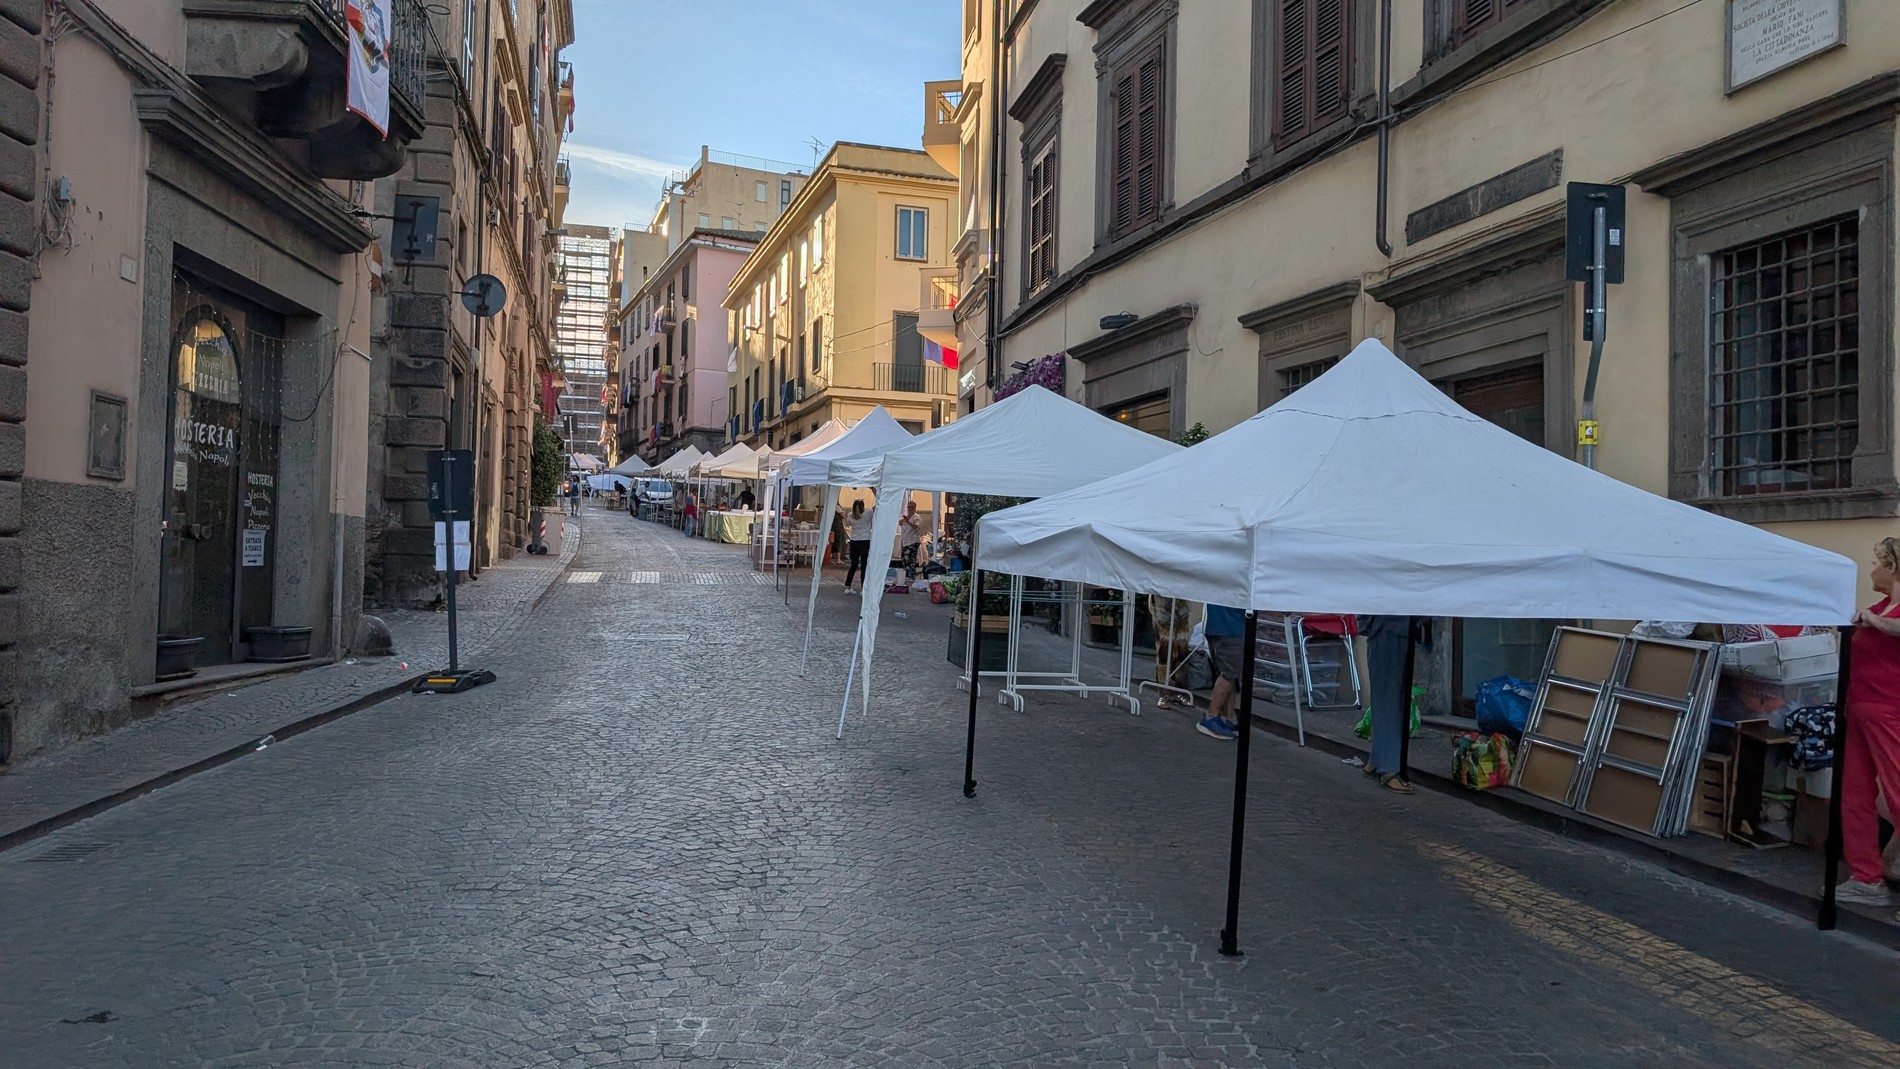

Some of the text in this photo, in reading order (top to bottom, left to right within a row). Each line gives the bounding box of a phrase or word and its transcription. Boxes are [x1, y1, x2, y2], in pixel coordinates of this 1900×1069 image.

[1762, 9, 1804, 35] MARIO FANI
[1752, 48, 1762, 58] LA
[1764, 23, 1814, 52] CITTADINANZA
[174, 418, 234, 449] HOSTERIA
[198, 449, 230, 467] Napoli
[247, 471, 274, 488] HOSTERIA
[247, 488, 272, 504] Vecchia
